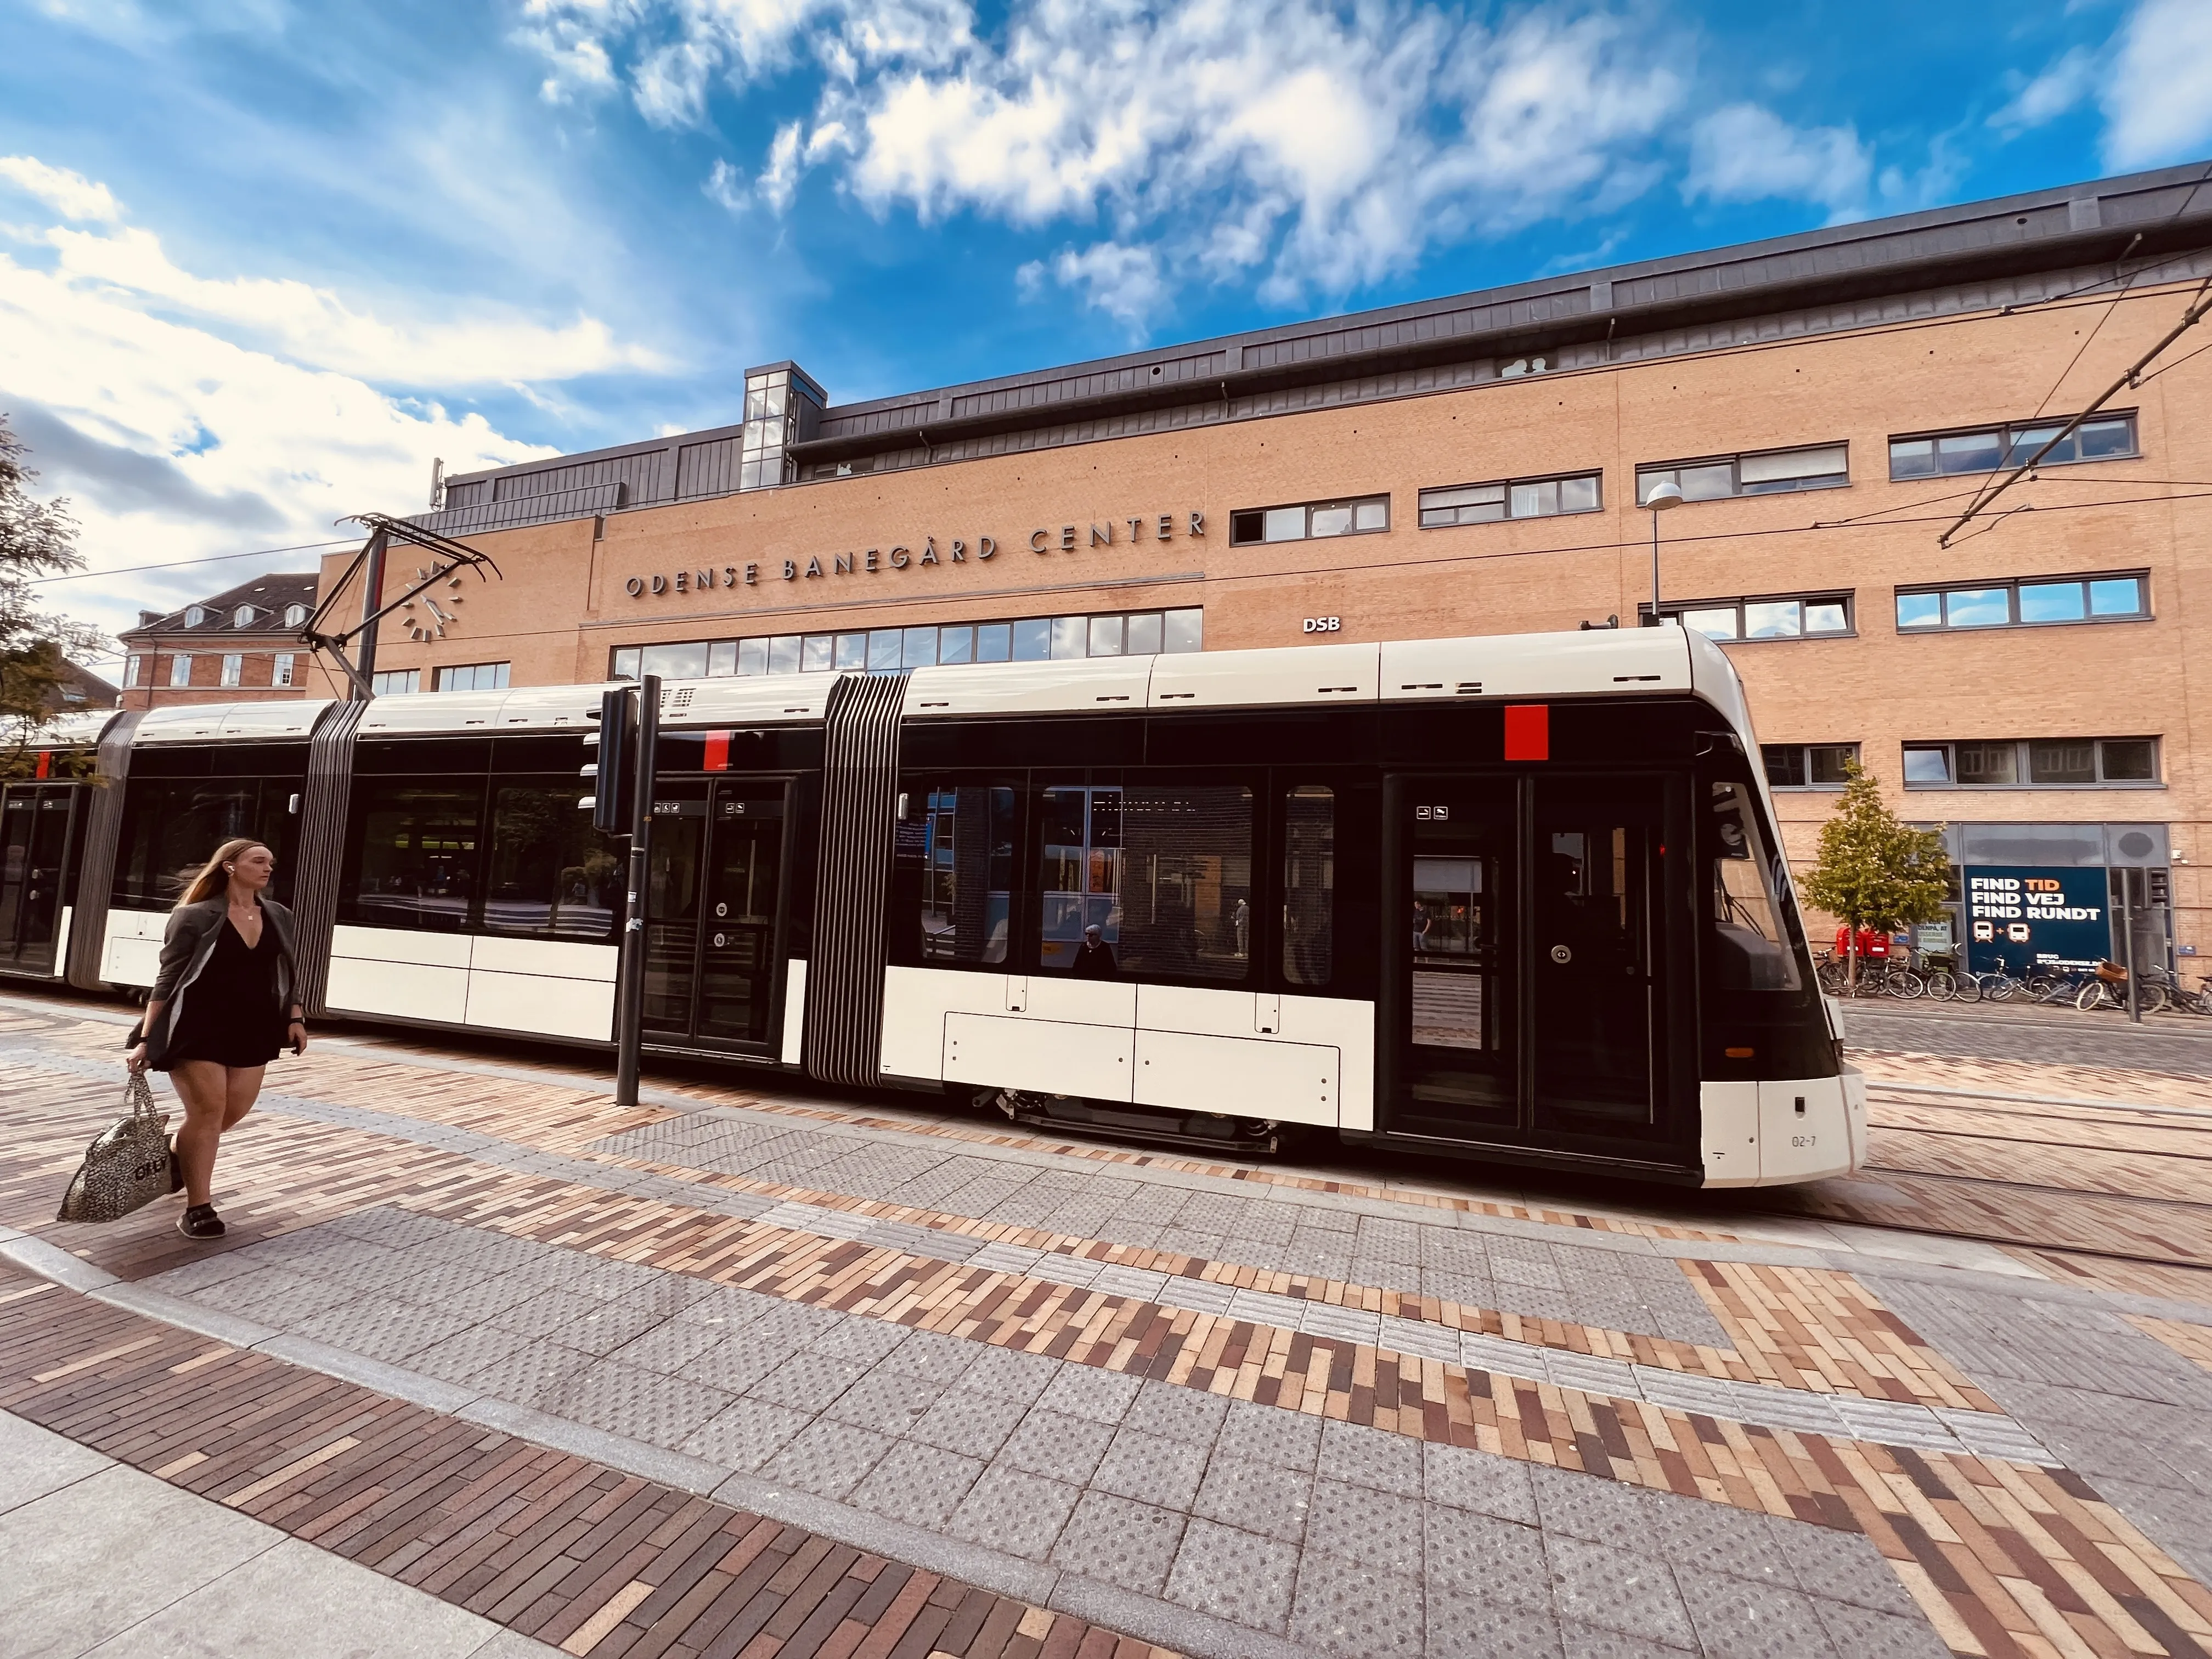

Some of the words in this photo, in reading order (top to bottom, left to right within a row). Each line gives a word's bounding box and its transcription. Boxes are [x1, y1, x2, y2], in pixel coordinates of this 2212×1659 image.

[625, 562, 759, 596] ODENSE
[782, 535, 995, 580] BANEGÅRD
[1029, 511, 1204, 553] CENTER
[1303, 616, 1341, 633] DSB
[1971, 878, 2020, 890] FIND
[2024, 879, 2060, 891] TID
[1972, 891, 2021, 904] FIND
[2025, 893, 2064, 905] VEJ
[1972, 905, 2022, 918] FIND
[2027, 907, 2101, 920] RUNDT
[1792, 1136, 1816, 1147] 02-7
